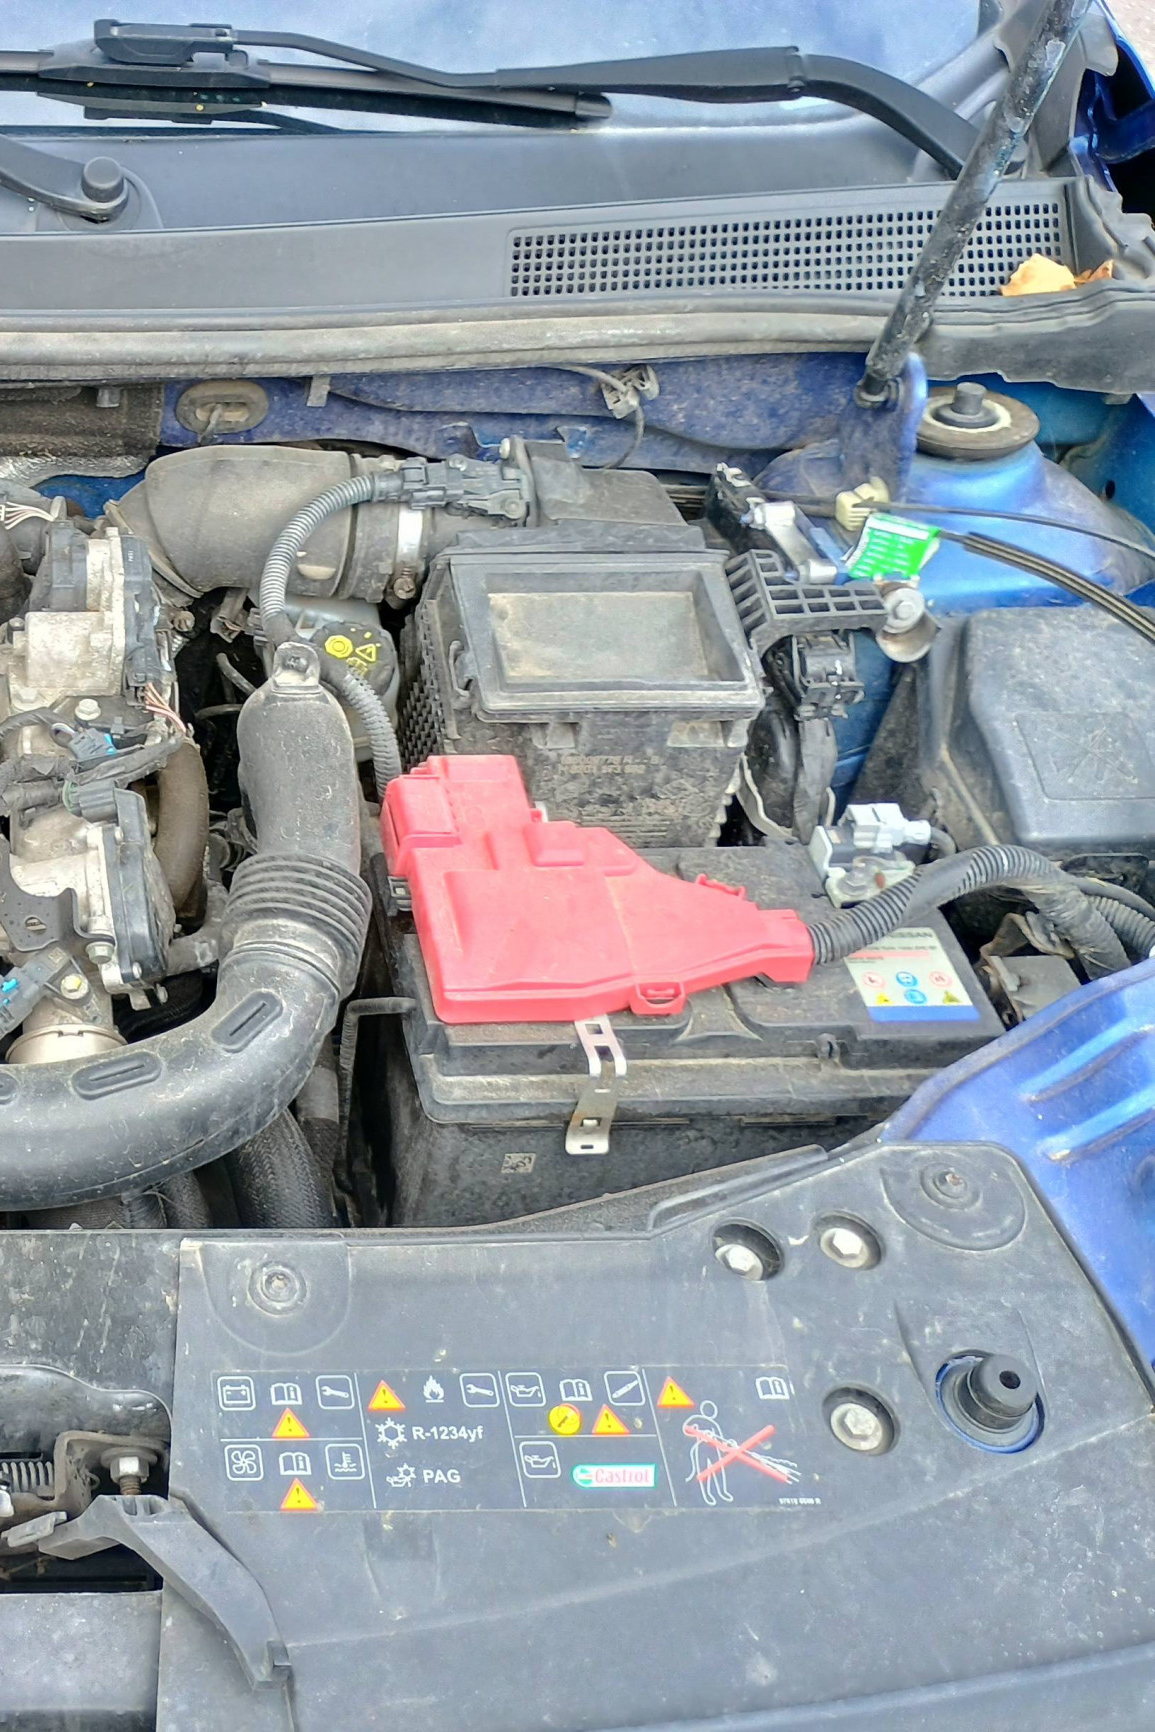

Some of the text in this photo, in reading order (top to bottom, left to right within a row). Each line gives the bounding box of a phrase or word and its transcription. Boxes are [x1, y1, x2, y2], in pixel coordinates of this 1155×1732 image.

[412, 1425, 484, 1443] R-1234yf
[422, 1468, 461, 1484] PAG
[595, 1468, 650, 1484] Castrol
